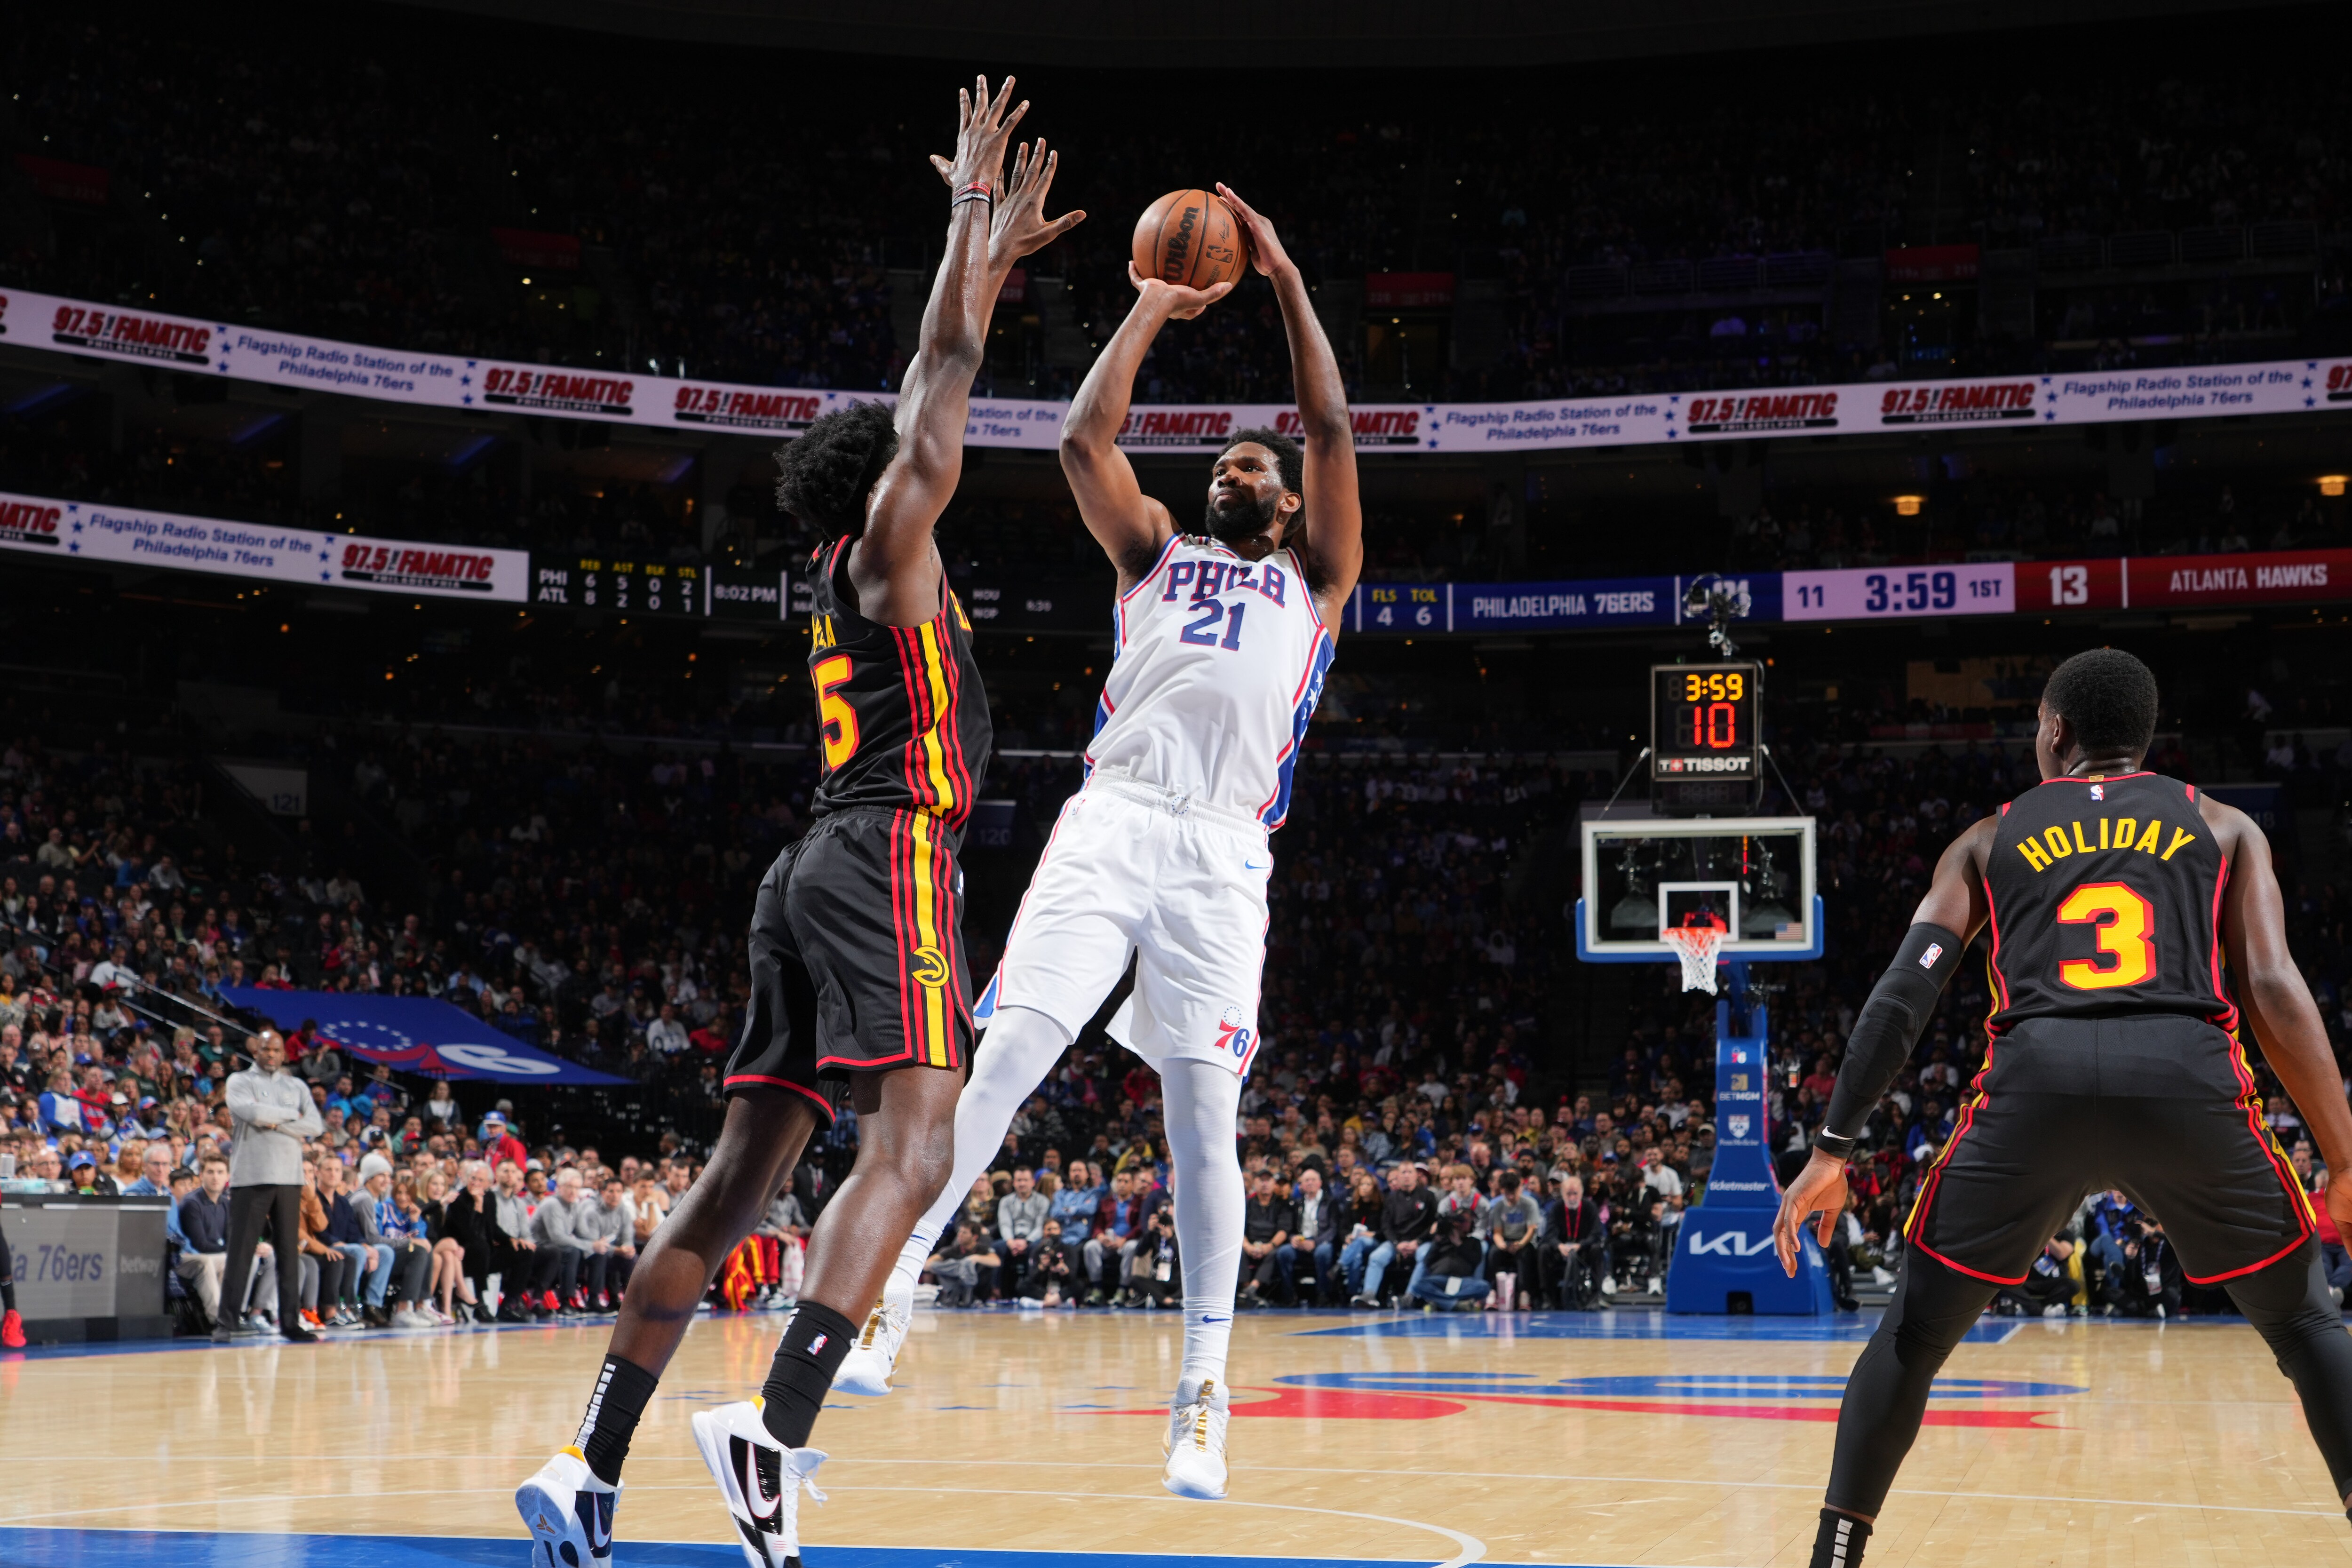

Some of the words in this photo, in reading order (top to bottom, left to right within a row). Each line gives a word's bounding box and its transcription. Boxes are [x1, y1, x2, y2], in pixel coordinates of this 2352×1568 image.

[53, 305, 104, 337] 97.5
[112, 315, 210, 353] FANATIC
[238, 334, 302, 358] Flagship
[306, 345, 348, 365] Radio
[353, 353, 405, 373] Station
[409, 362, 426, 375] of
[429, 363, 453, 377] the
[279, 360, 369, 385] Philadelphia
[373, 373, 414, 392] 76ers
[484, 368, 532, 395] 97.5
[540, 374, 634, 404] FANATIC
[2064, 380, 2131, 397] Flagship
[2136, 378, 2181, 391] Radio
[2187, 373, 2242, 389] Station
[2247, 372, 2266, 384] of
[2268, 371, 2293, 383] the
[674, 386, 720, 413] 97.5
[729, 392, 821, 419] FANATIC
[1687, 398, 1736, 422] 97.5
[1743, 392, 1838, 420] FANATIC
[1880, 387, 1930, 413] 97.5
[1938, 382, 2035, 409] FANATIC
[2107, 394, 2205, 411] Philadelphia
[2210, 392, 2253, 405] 76ers
[969, 407, 1012, 421] tation
[1017, 408, 1033, 421] of
[1036, 409, 1058, 422] the
[1141, 412, 1232, 436] FANATIC
[1275, 411, 1305, 434] 97.
[1446, 411, 1508, 426] Flagship
[1513, 408, 1555, 423] Radio
[1559, 404, 1611, 420] Station
[1615, 404, 1631, 417] of
[1634, 402, 1657, 416] the
[983, 424, 1022, 437] 76ers
[1486, 423, 1576, 441] Philadelphia
[1581, 423, 1620, 436] 76ers
[90, 513, 158, 537] Flagship
[163, 522, 207, 541] Radio
[212, 528, 265, 548] Station
[270, 535, 286, 549] of
[289, 538, 312, 553] the
[134, 538, 229, 562] Philadelphia
[233, 549, 274, 567] 76ers
[342, 544, 389, 572] 97.5
[397, 549, 494, 581] FANATIC
[372, 574, 461, 589] PHILADELPHIA
[539, 568, 568, 586] PHI
[585, 573, 596, 588] 6
[617, 575, 628, 590] 5
[649, 578, 661, 593] 0
[681, 581, 692, 596] 2
[612, 561, 634, 574] AST
[645, 565, 666, 576] BLK
[678, 566, 697, 579] STL
[2170, 568, 2249, 592] ATLANTA
[2256, 564, 2328, 588] HAWKS
[714, 583, 749, 601] 8:02
[752, 587, 778, 603] PM
[1372, 589, 1397, 603] FLS
[1410, 589, 1438, 603] TOL
[1797, 585, 1824, 608] 11
[1865, 572, 1956, 612] 3:59
[1969, 579, 2002, 598] 1ST
[2049, 565, 2088, 605] 13
[538, 586, 568, 604] ATL
[584, 590, 596, 605] 8
[617, 593, 628, 608] 2
[649, 595, 660, 610] 0
[683, 598, 691, 612] 1
[1472, 595, 1587, 618] PHILADELPHIA
[1594, 591, 1655, 615] 76ERS
[1179, 599, 1246, 652] 21
[1376, 606, 1394, 626] 4
[1415, 606, 1432, 626] 6
[1686, 673, 1743, 701] 3:59
[1694, 702, 1735, 748] 10
[1684, 756, 1751, 772] TISSOT
[273, 794, 299, 812] 121
[2017, 818, 2196, 872] HOLIDAY
[2057, 881, 2157, 990] 3
[1214, 1019, 1250, 1058] 76
[1719, 1091, 1760, 1101] BETMGM
[1709, 1179, 1768, 1192] ticketmaster
[38, 1245, 103, 1282] 76ers
